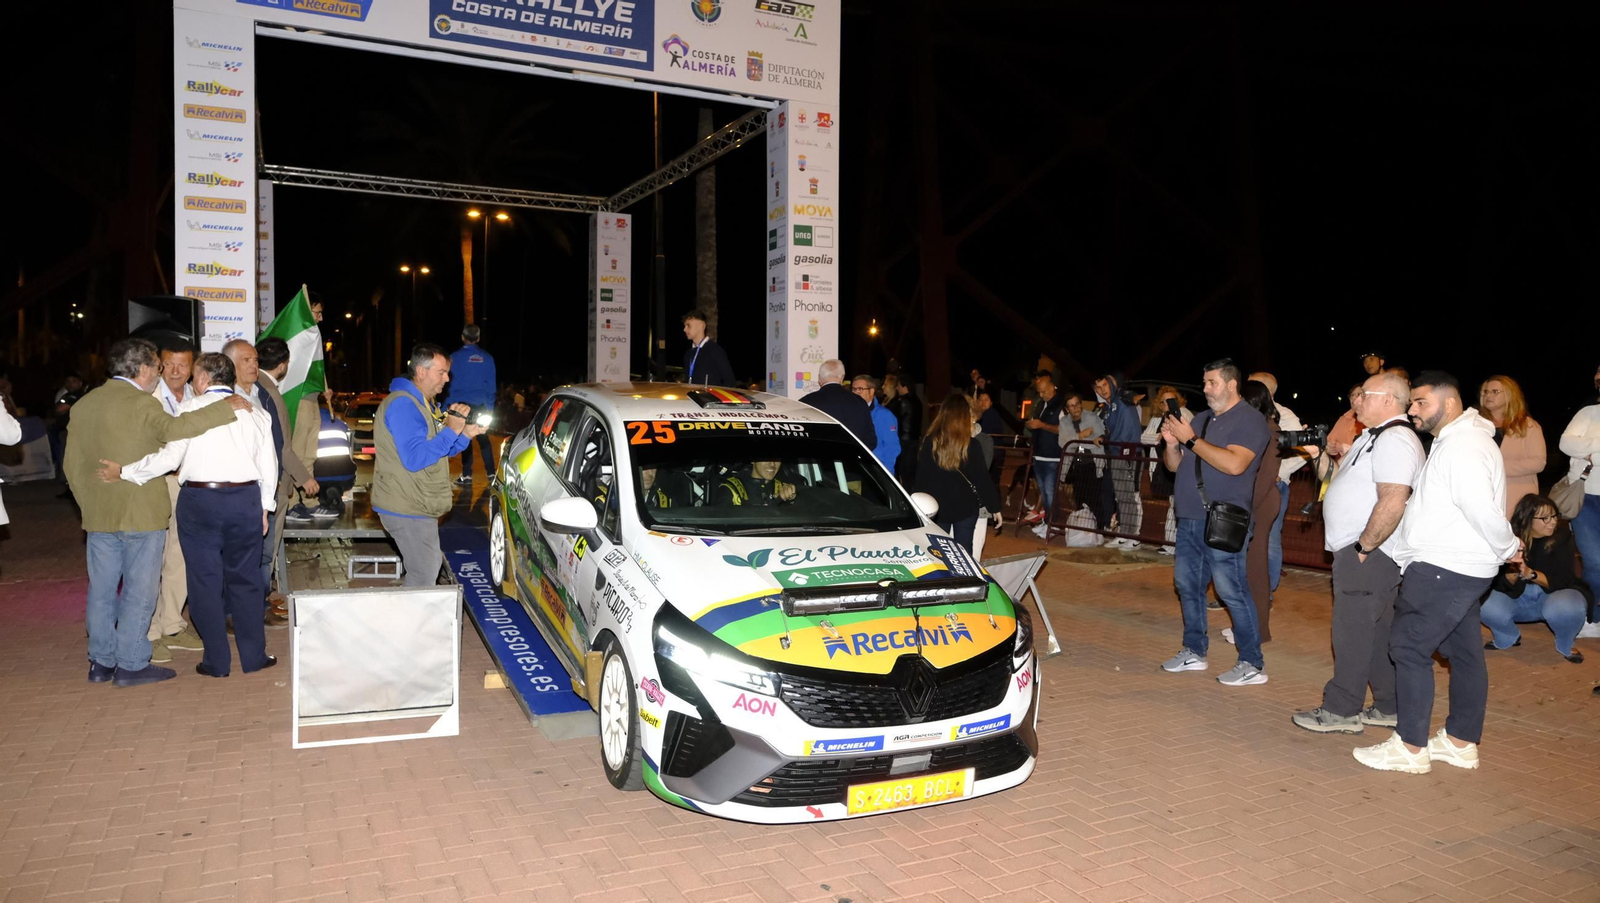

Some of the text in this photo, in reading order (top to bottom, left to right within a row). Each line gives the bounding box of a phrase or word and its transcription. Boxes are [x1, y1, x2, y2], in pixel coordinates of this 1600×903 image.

[451, 1, 633, 40] COSTA DE ALMERÍA
[201, 42, 243, 51] MICHELIN
[692, 50, 736, 64] COSTA DE
[682, 60, 737, 78] ALMERÍA
[768, 63, 825, 80] DIPUTACIÓN
[187, 80, 244, 97] Rallycar
[768, 74, 823, 91] DE ALMERÍA
[196, 107, 234, 120] Recalvi
[202, 133, 244, 142] MICHELIN
[187, 172, 244, 188] Rallycar
[196, 199, 234, 211] Recalvi
[202, 223, 244, 232] MICHELIN
[794, 232, 812, 240] UNED
[793, 254, 833, 266] gasolia
[187, 263, 244, 278] Rallycar
[196, 288, 234, 301] Recalvi
[600, 306, 627, 314] gasolia
[794, 299, 833, 313] Phonika
[202, 314, 244, 323] MICHELIN
[601, 334, 627, 343] Phonika
[718, 411, 789, 420] INDALCAMPO
[626, 421, 677, 445] 25
[678, 421, 805, 432] DRIVELAND
[749, 430, 810, 438] MOTORSPORT
[778, 545, 925, 566] El Plantel
[811, 568, 905, 580] TECNOCASA
[851, 626, 949, 656] Recalvi
[1016, 669, 1034, 693] AON
[732, 692, 777, 717] AON
[968, 719, 1006, 734] MICHELIN
[827, 740, 876, 750] MICHELIN
[855, 777, 954, 809] S 2463 BCL
